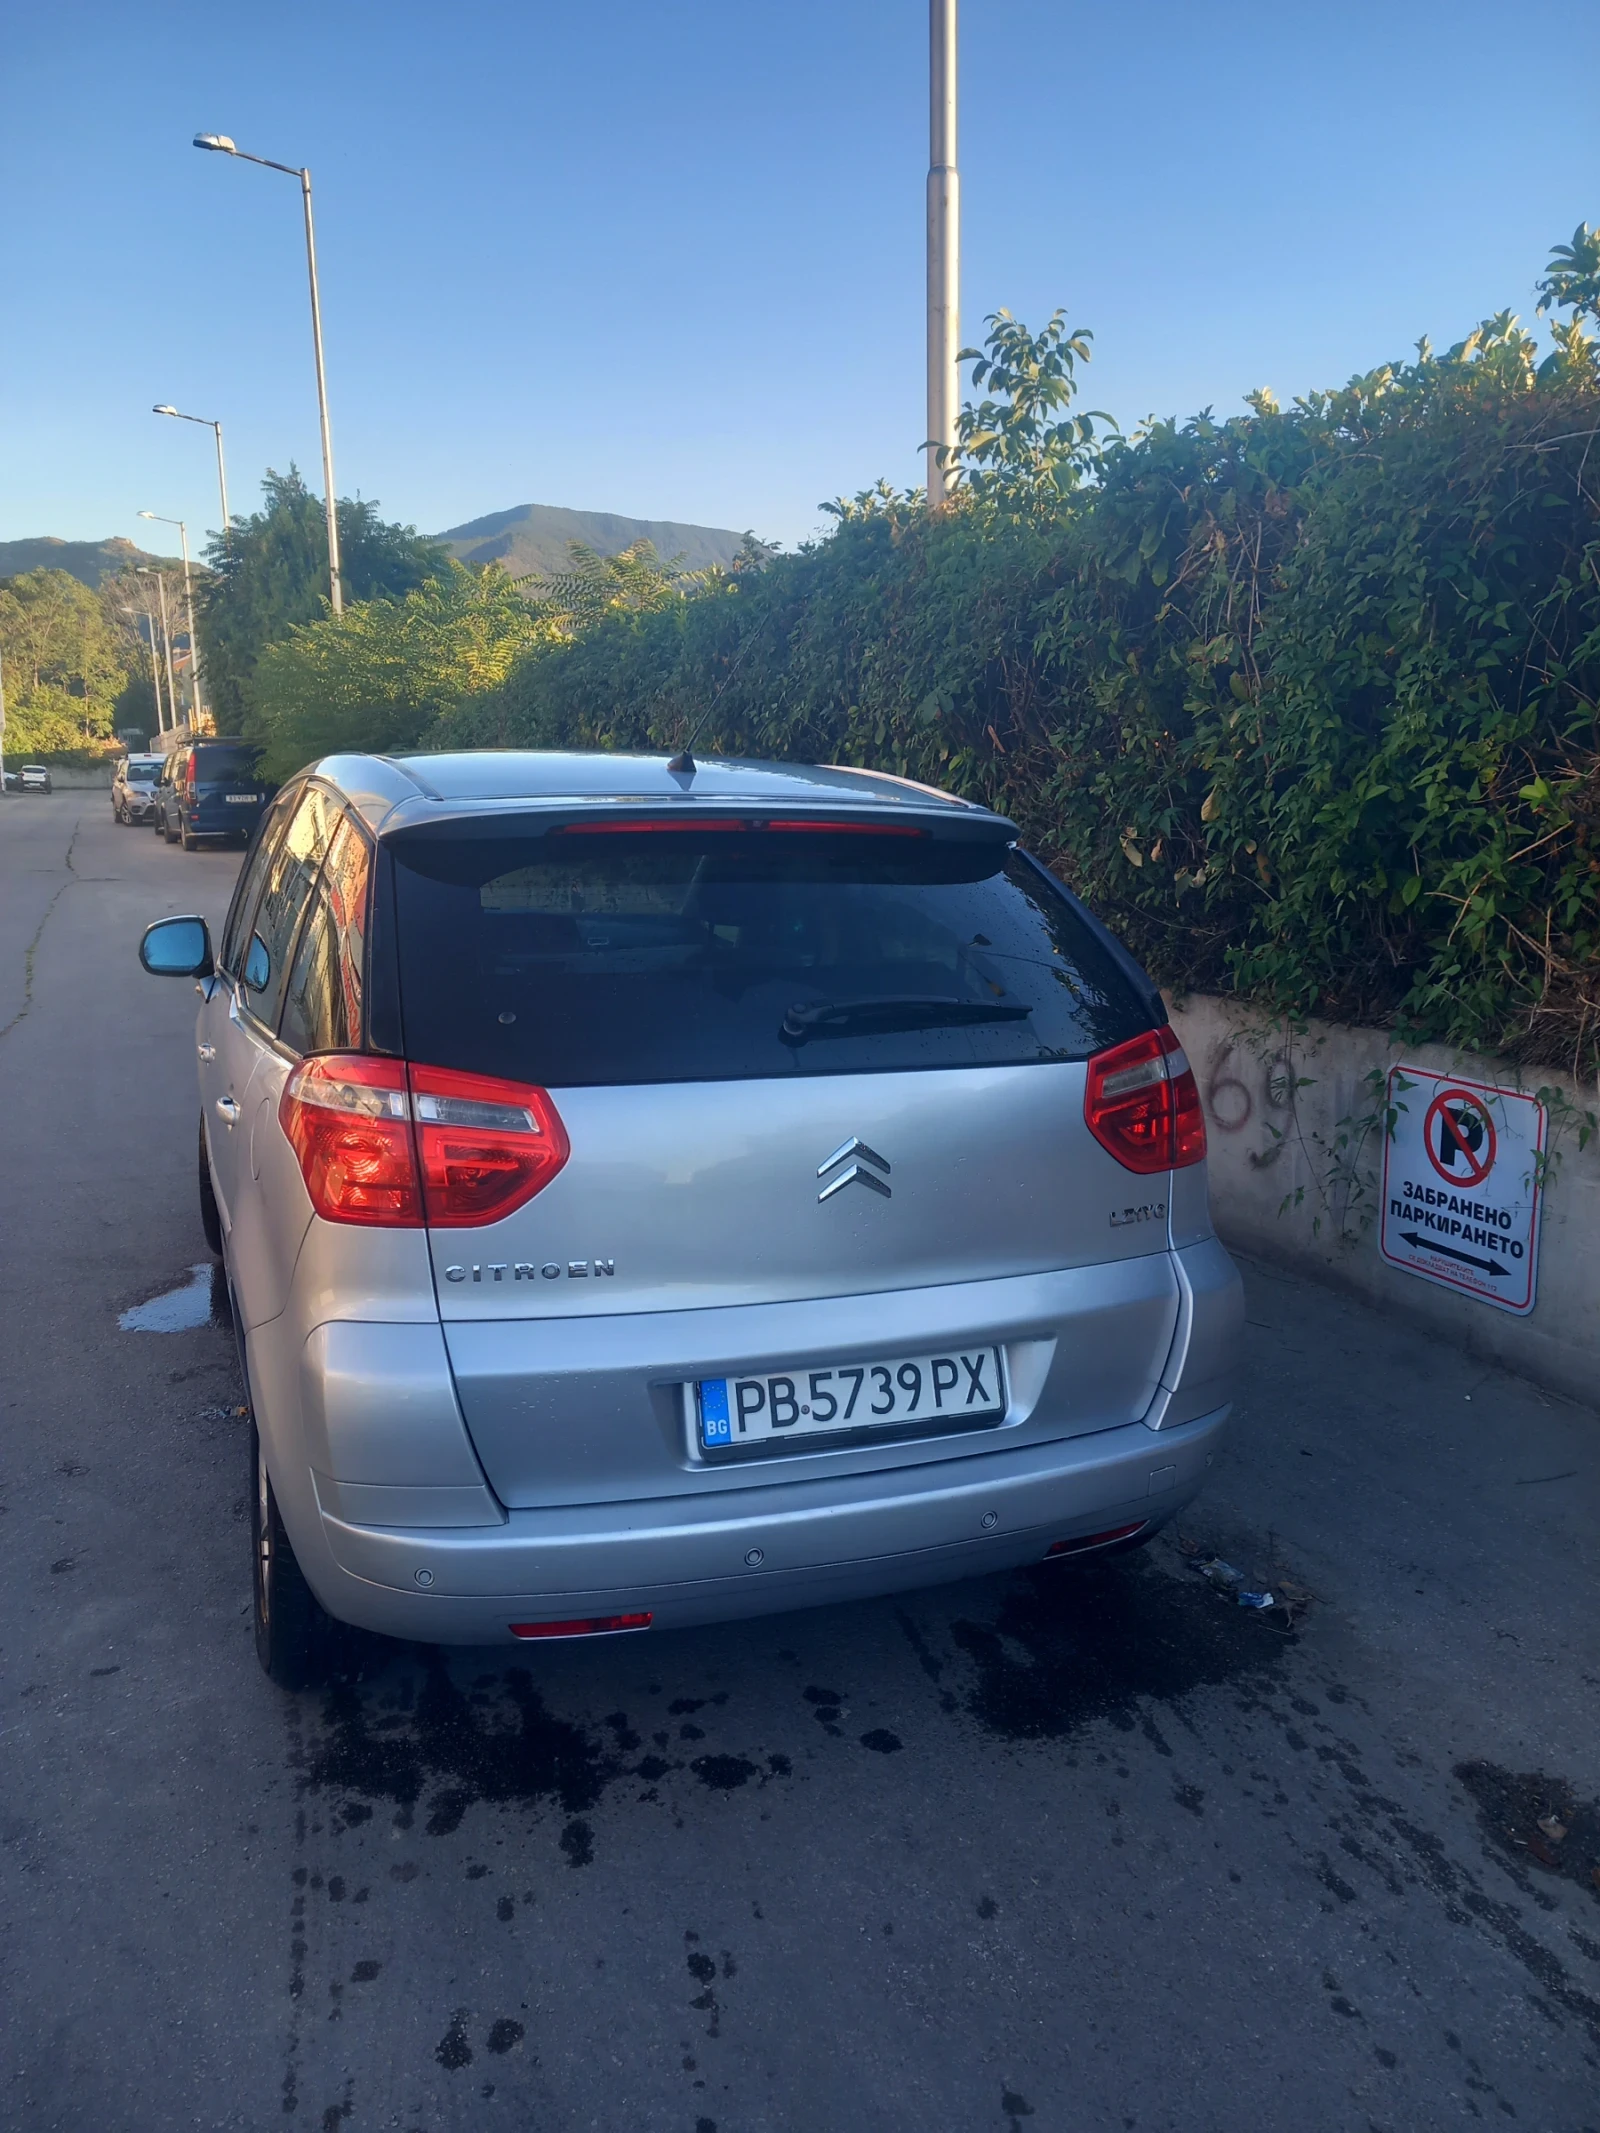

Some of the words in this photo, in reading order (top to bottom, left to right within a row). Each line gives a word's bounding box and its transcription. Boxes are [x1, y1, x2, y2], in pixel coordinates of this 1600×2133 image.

[1403, 1181, 1512, 1229] ЗАБРАНЕНО
[1390, 1200, 1524, 1259] ПАРКИРАНЕТО
[445, 1259, 615, 1283] CITROEN
[706, 1419, 728, 1436] BG
